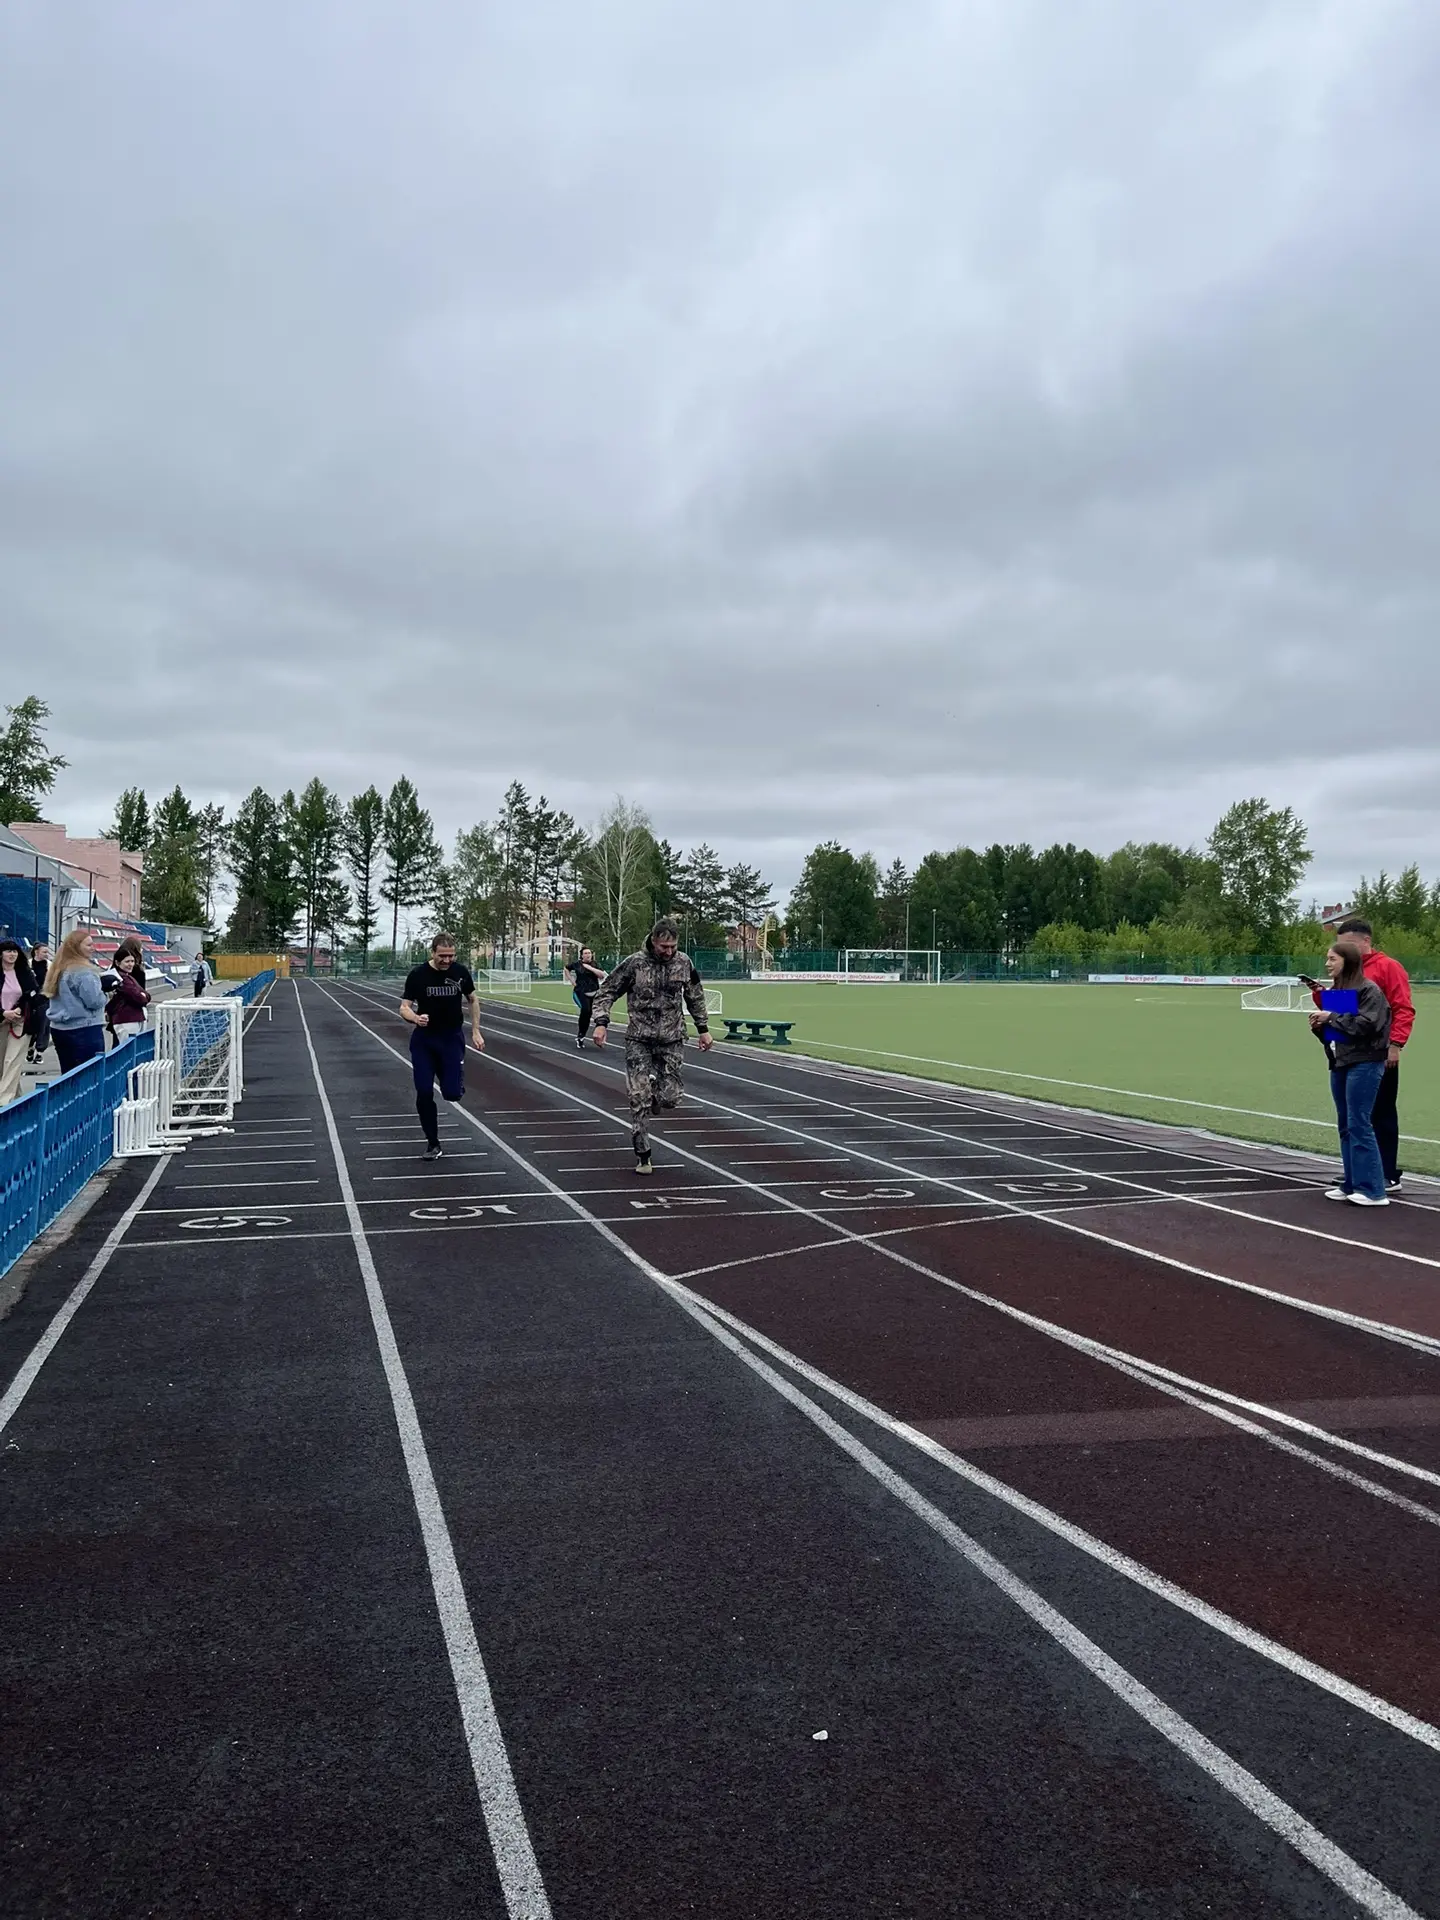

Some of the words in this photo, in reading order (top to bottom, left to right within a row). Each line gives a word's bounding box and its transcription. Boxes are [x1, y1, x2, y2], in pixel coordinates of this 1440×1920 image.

[819, 1187, 916, 1201] 3
[994, 1181, 1089, 1195] 2
[629, 1195, 728, 1209] 4
[409, 1204, 518, 1220] 5
[178, 1215, 292, 1229] 6
